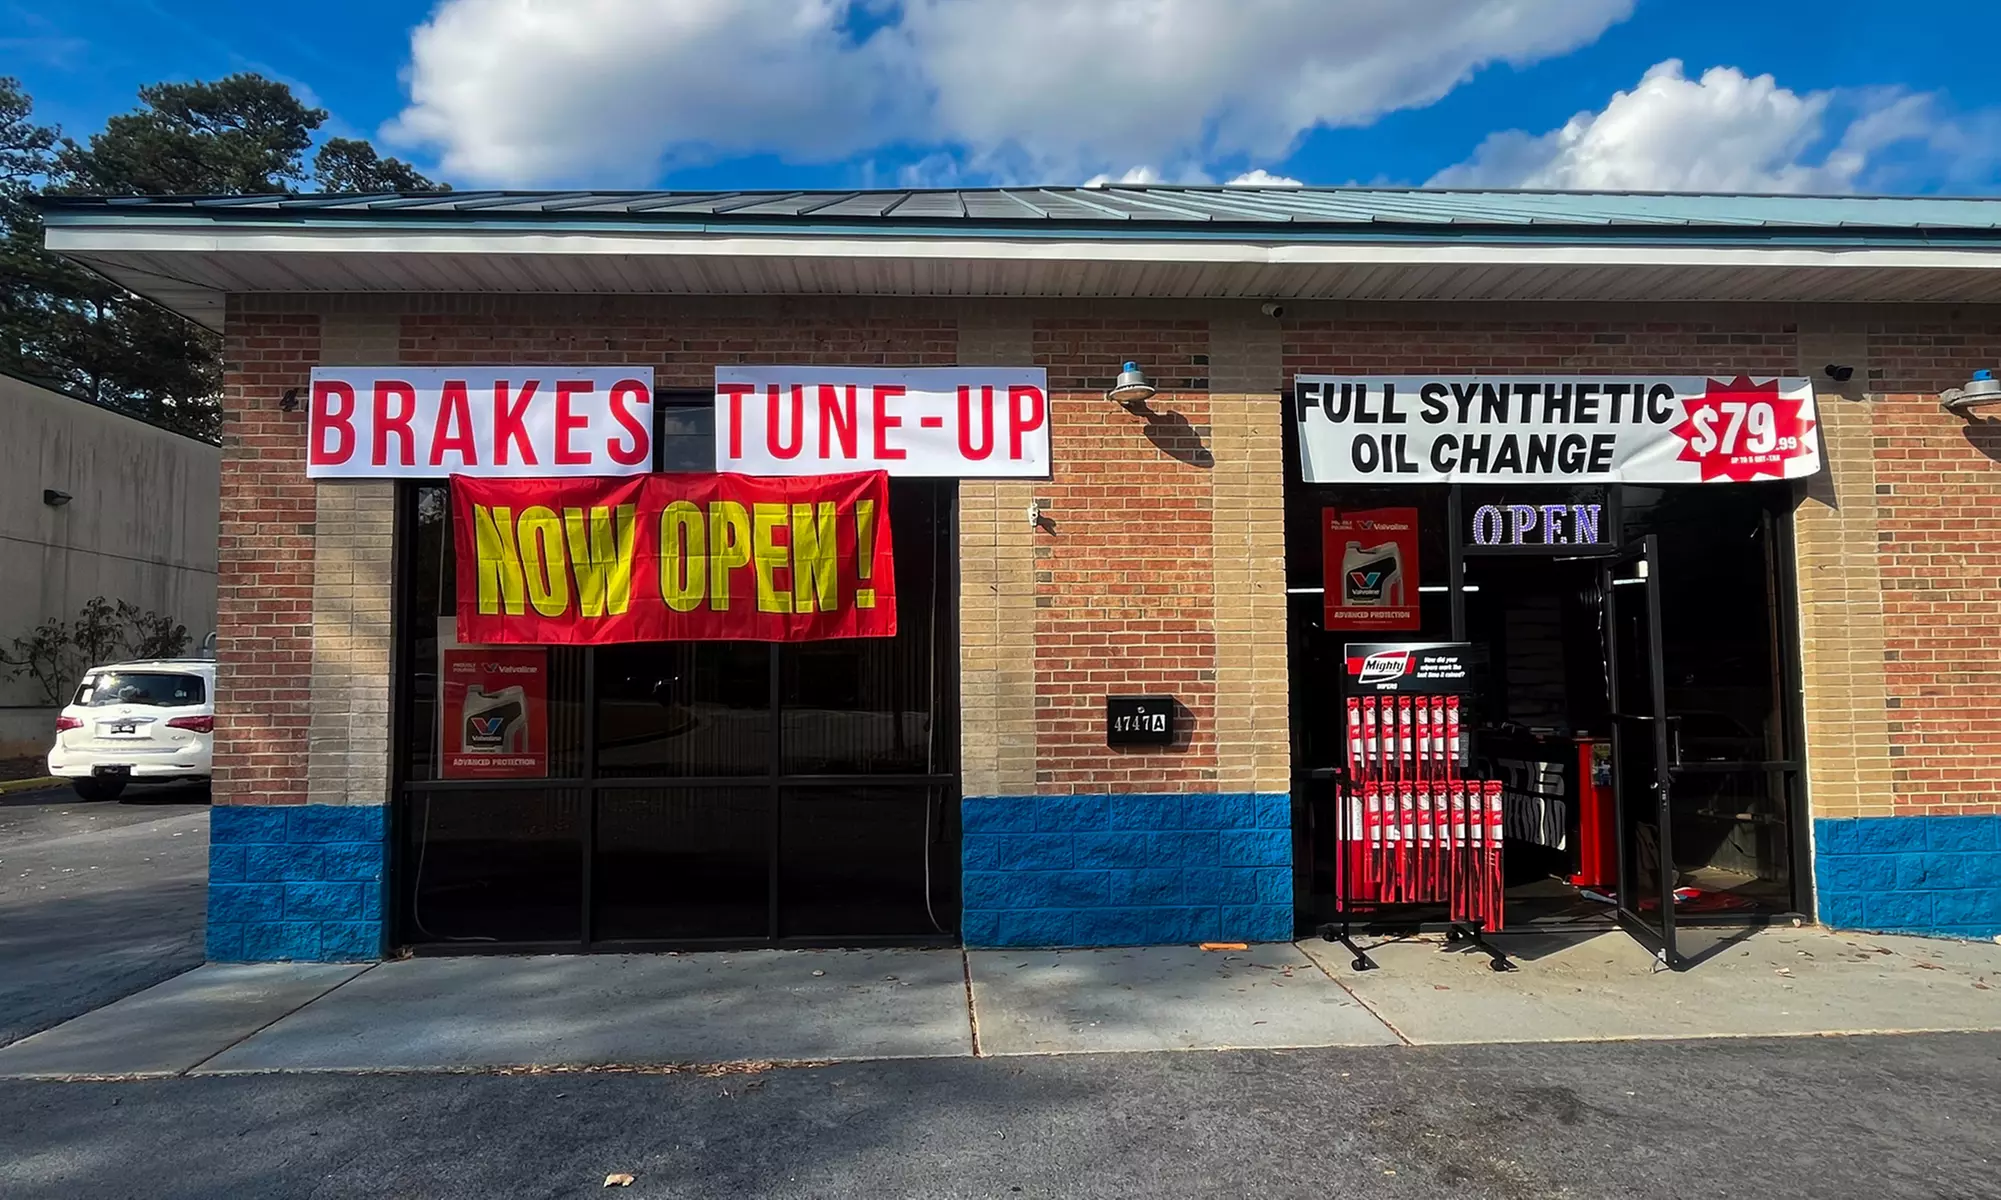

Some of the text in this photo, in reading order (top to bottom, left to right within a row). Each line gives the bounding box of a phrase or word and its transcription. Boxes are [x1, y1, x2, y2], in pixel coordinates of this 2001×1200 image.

[310, 379, 650, 466] BRAKES
[717, 383, 1045, 461] TUNE-UP
[1296, 382, 1675, 424] FULL SYNTHETIC
[1351, 433, 1617, 474] OIL CHANGE
[1373, 523, 1409, 531] Valvoline
[1472, 504, 1602, 545] OPEN
[473, 502, 636, 618] NOW
[1334, 611, 1411, 619] ADVANCED PROTECTION
[498, 665, 538, 674] Valvoline
[1365, 660, 1405, 673] Mighty
[453, 758, 536, 767] ADVANCED PROTECTION
